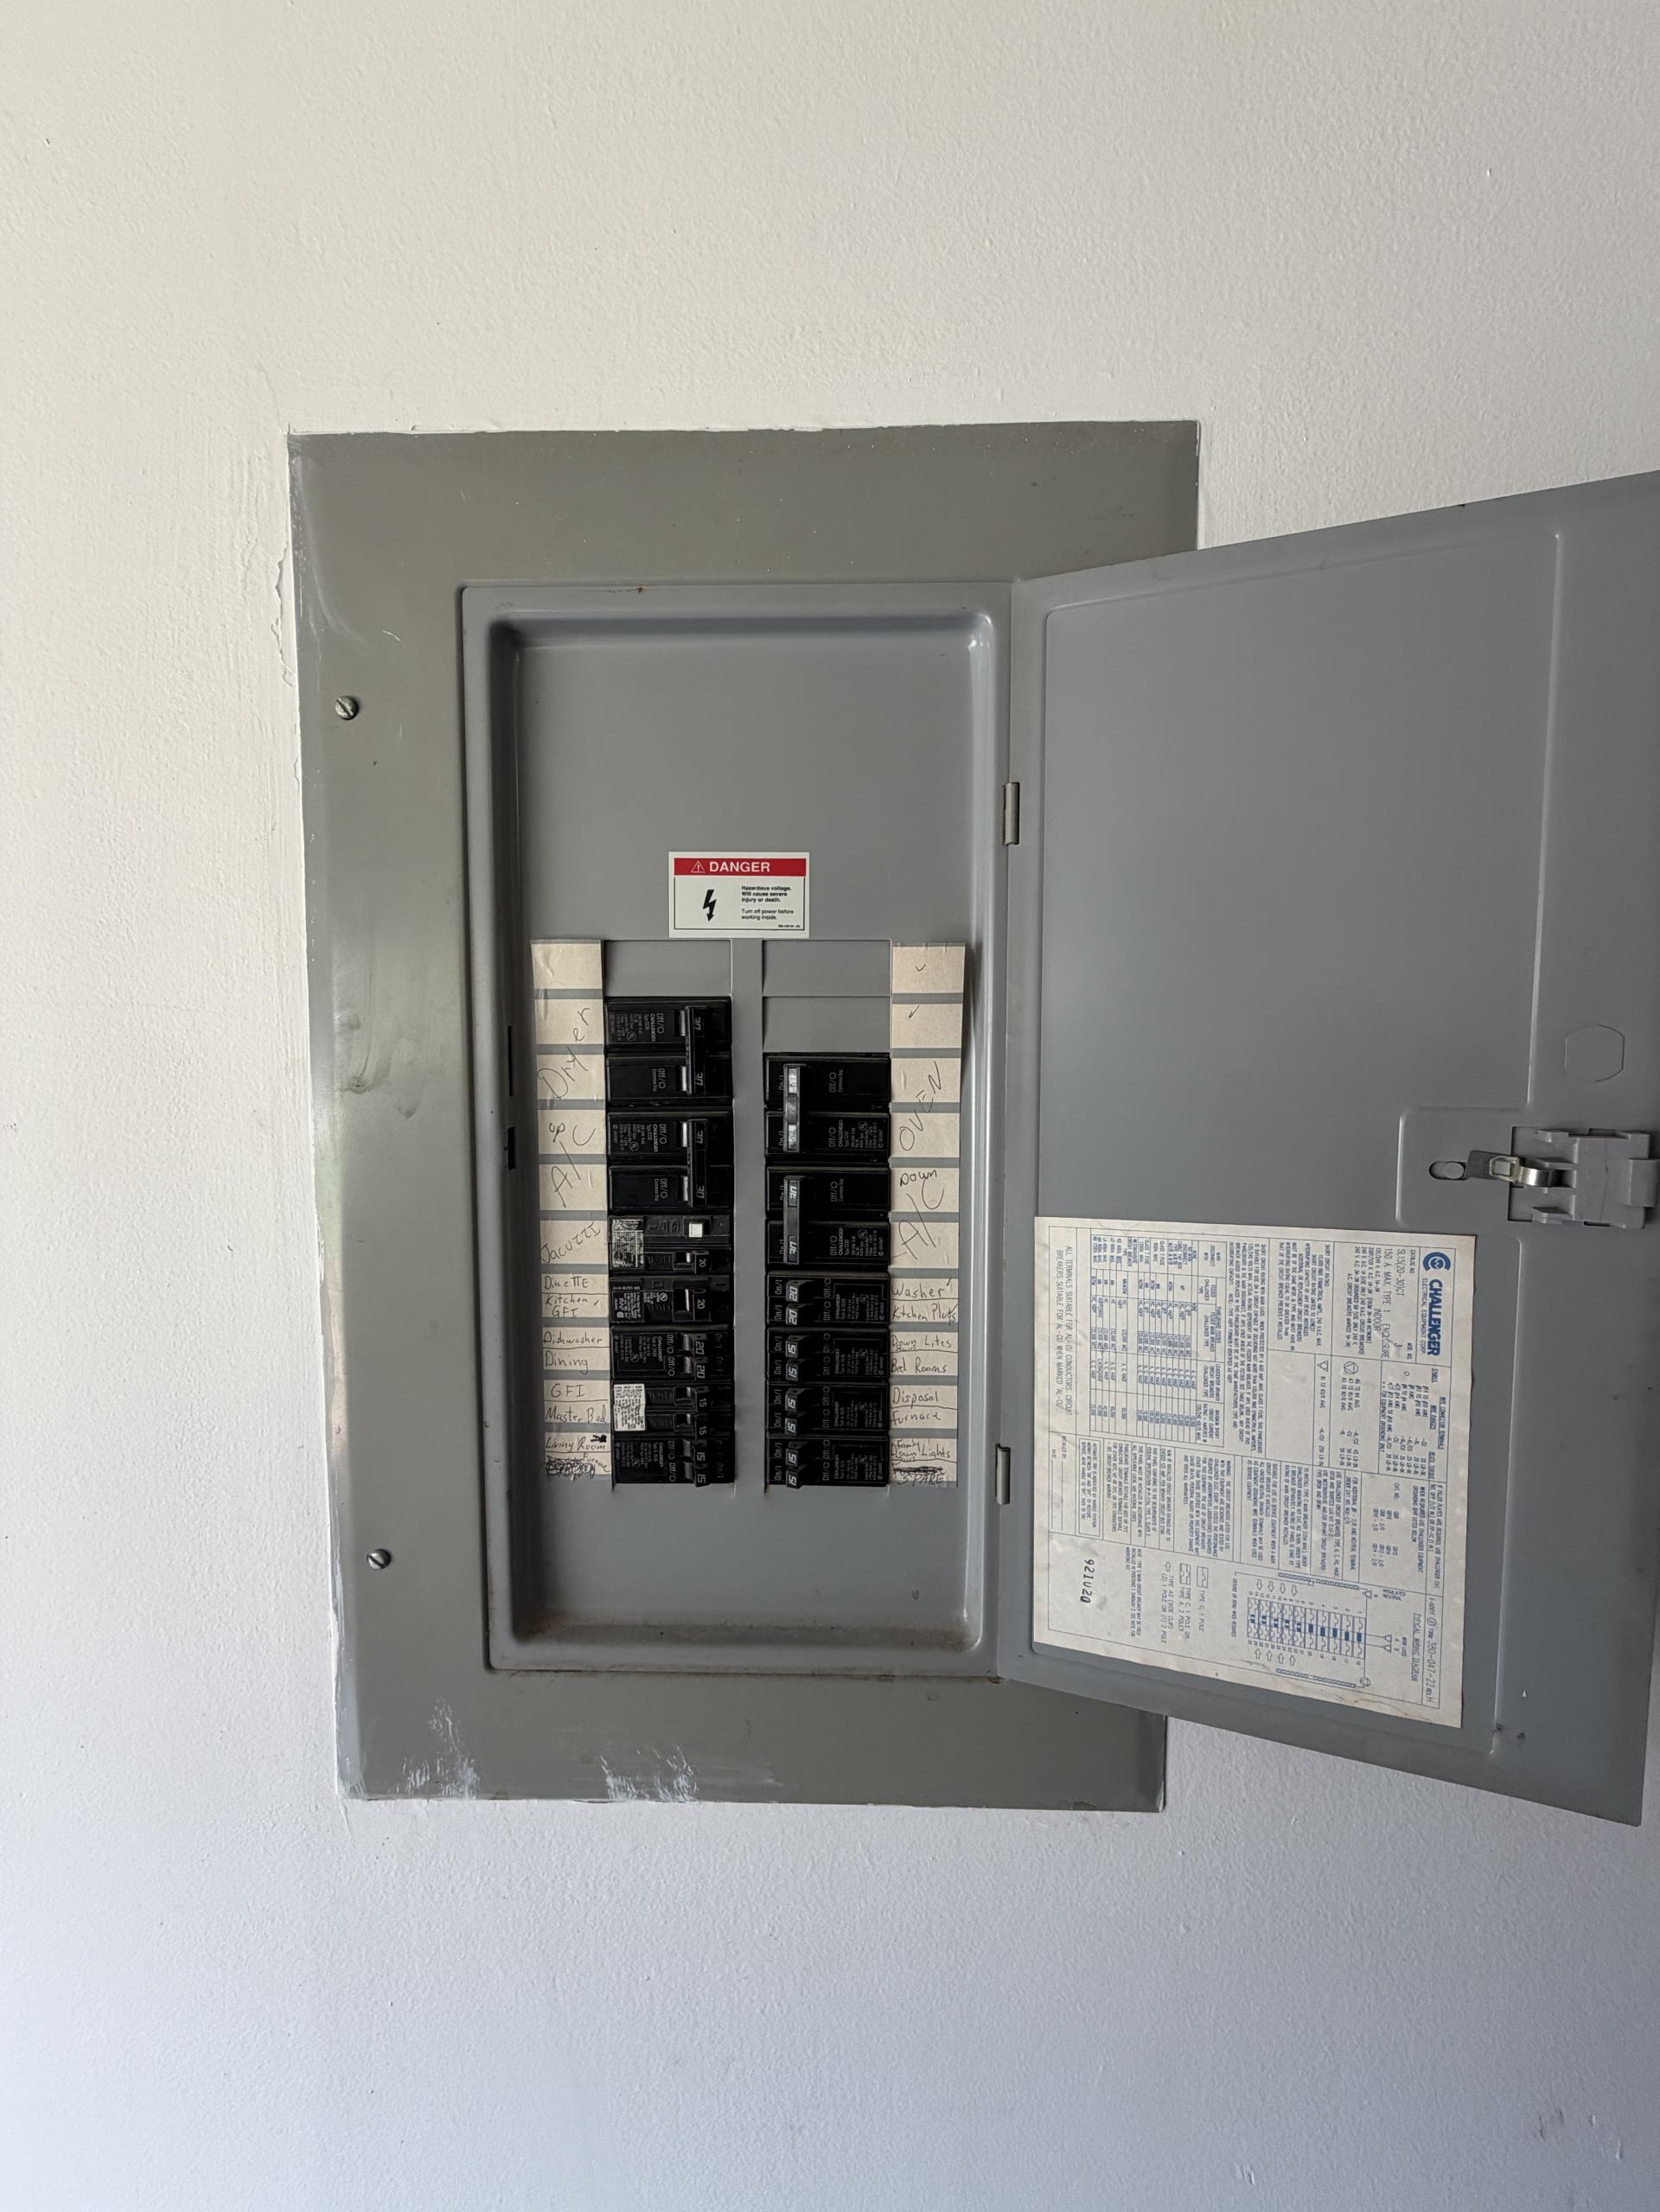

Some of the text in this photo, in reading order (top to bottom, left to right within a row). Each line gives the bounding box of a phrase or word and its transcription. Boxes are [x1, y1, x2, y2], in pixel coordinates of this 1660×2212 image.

[710, 861, 770, 872] DANGER
[537, 1006, 591, 1100] Dryer
[899, 1060, 942, 1151] OVEN
[551, 1125, 596, 1208] A/C
[696, 1185, 705, 1198] 30
[898, 1178, 944, 1260] A/C
[1384, 1248, 1393, 1259] 150
[699, 1259, 706, 1267] 20
[789, 1286, 797, 1301] 20
[891, 1282, 946, 1298] Washer
[697, 1299, 706, 1309] 20
[1382, 1291, 1391, 1305] TYPE
[788, 1310, 797, 1325] 20
[1373, 1308, 1382, 1331] INDOOR
[1427, 1279, 1443, 1356] CHALLENGER
[1381, 1323, 1390, 1359] ENCLOSURE
[695, 1342, 704, 1355] 20
[788, 1343, 795, 1355] 15
[545, 1349, 589, 1375] Dining
[915, 1356, 948, 1374] Rooms
[697, 1365, 705, 1379] 20
[788, 1367, 796, 1378] 15
[551, 1382, 585, 1398] GFI
[699, 1398, 707, 1407] 15
[788, 1398, 795, 1409] 15
[892, 1386, 939, 1410] Disposal
[546, 1405, 584, 1423] Master
[891, 1410, 942, 1426] Furnace
[699, 1426, 707, 1436] 15
[788, 1422, 795, 1433] 15
[546, 1436, 605, 1452] Living Room
[921, 1443, 951, 1458] Lights
[698, 1452, 706, 1461] 15
[788, 1452, 796, 1463] 15
[698, 1474, 706, 1482] 15
[788, 1475, 796, 1486] 15
